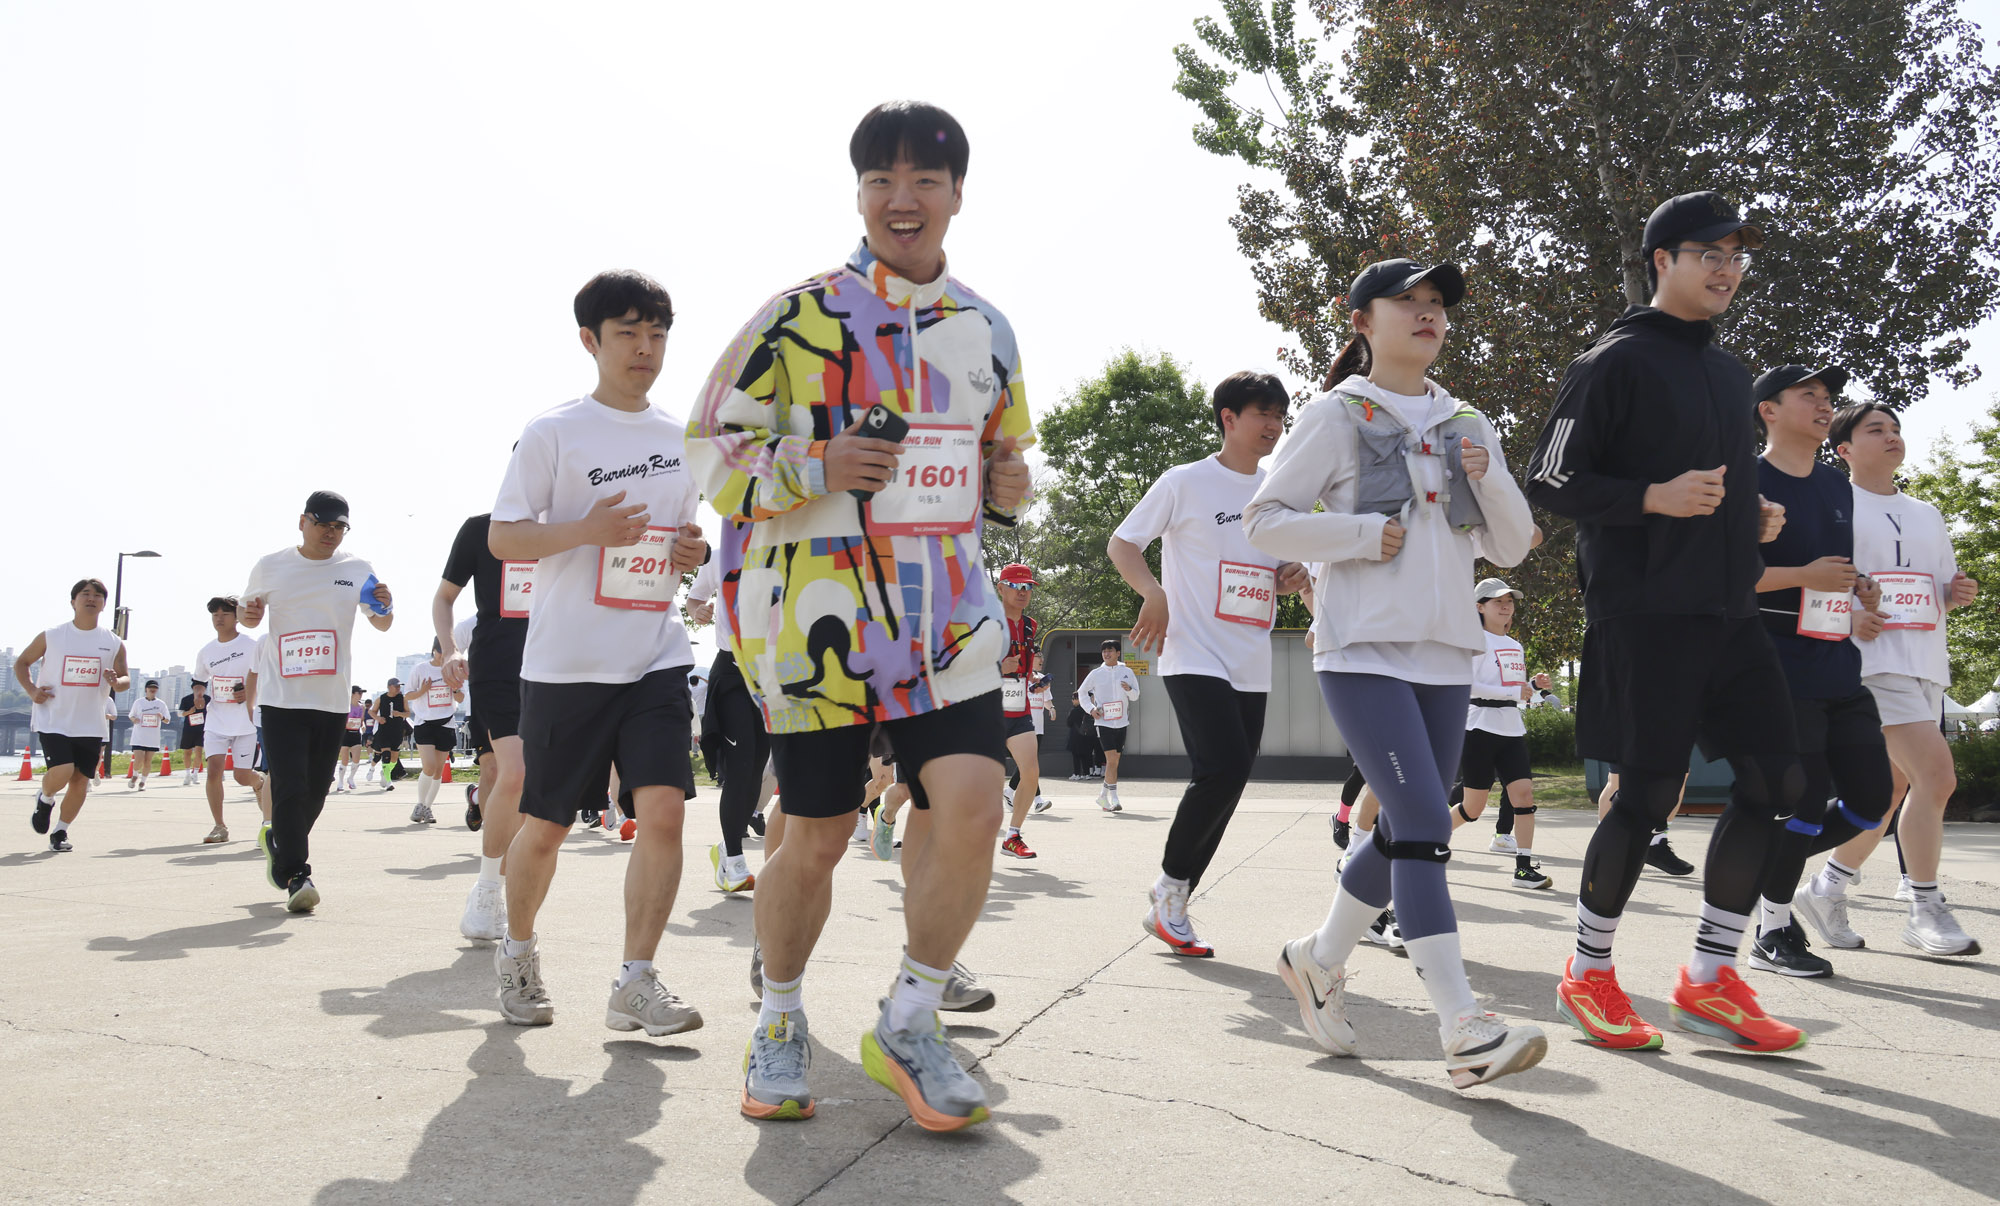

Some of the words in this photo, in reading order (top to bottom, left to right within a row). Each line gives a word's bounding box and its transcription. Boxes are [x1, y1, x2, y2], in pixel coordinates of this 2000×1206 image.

[923, 436, 943, 445] RUN
[588, 464, 649, 487] Burning
[648, 454, 681, 472] Run
[905, 465, 968, 488] 1601
[649, 535, 666, 544] RUN
[611, 556, 627, 569] M
[1225, 567, 1249, 576] BURNING
[334, 579, 354, 588] HOKA
[510, 583, 520, 592] M
[1227, 585, 1236, 594] M
[1237, 585, 1270, 602] 2465
[1811, 599, 1822, 609] M
[1883, 594, 1892, 603] M
[1895, 593, 1931, 606] 2071
[286, 649, 295, 657] M
[297, 645, 331, 657] 1916
[75, 667, 98, 675] 1643
